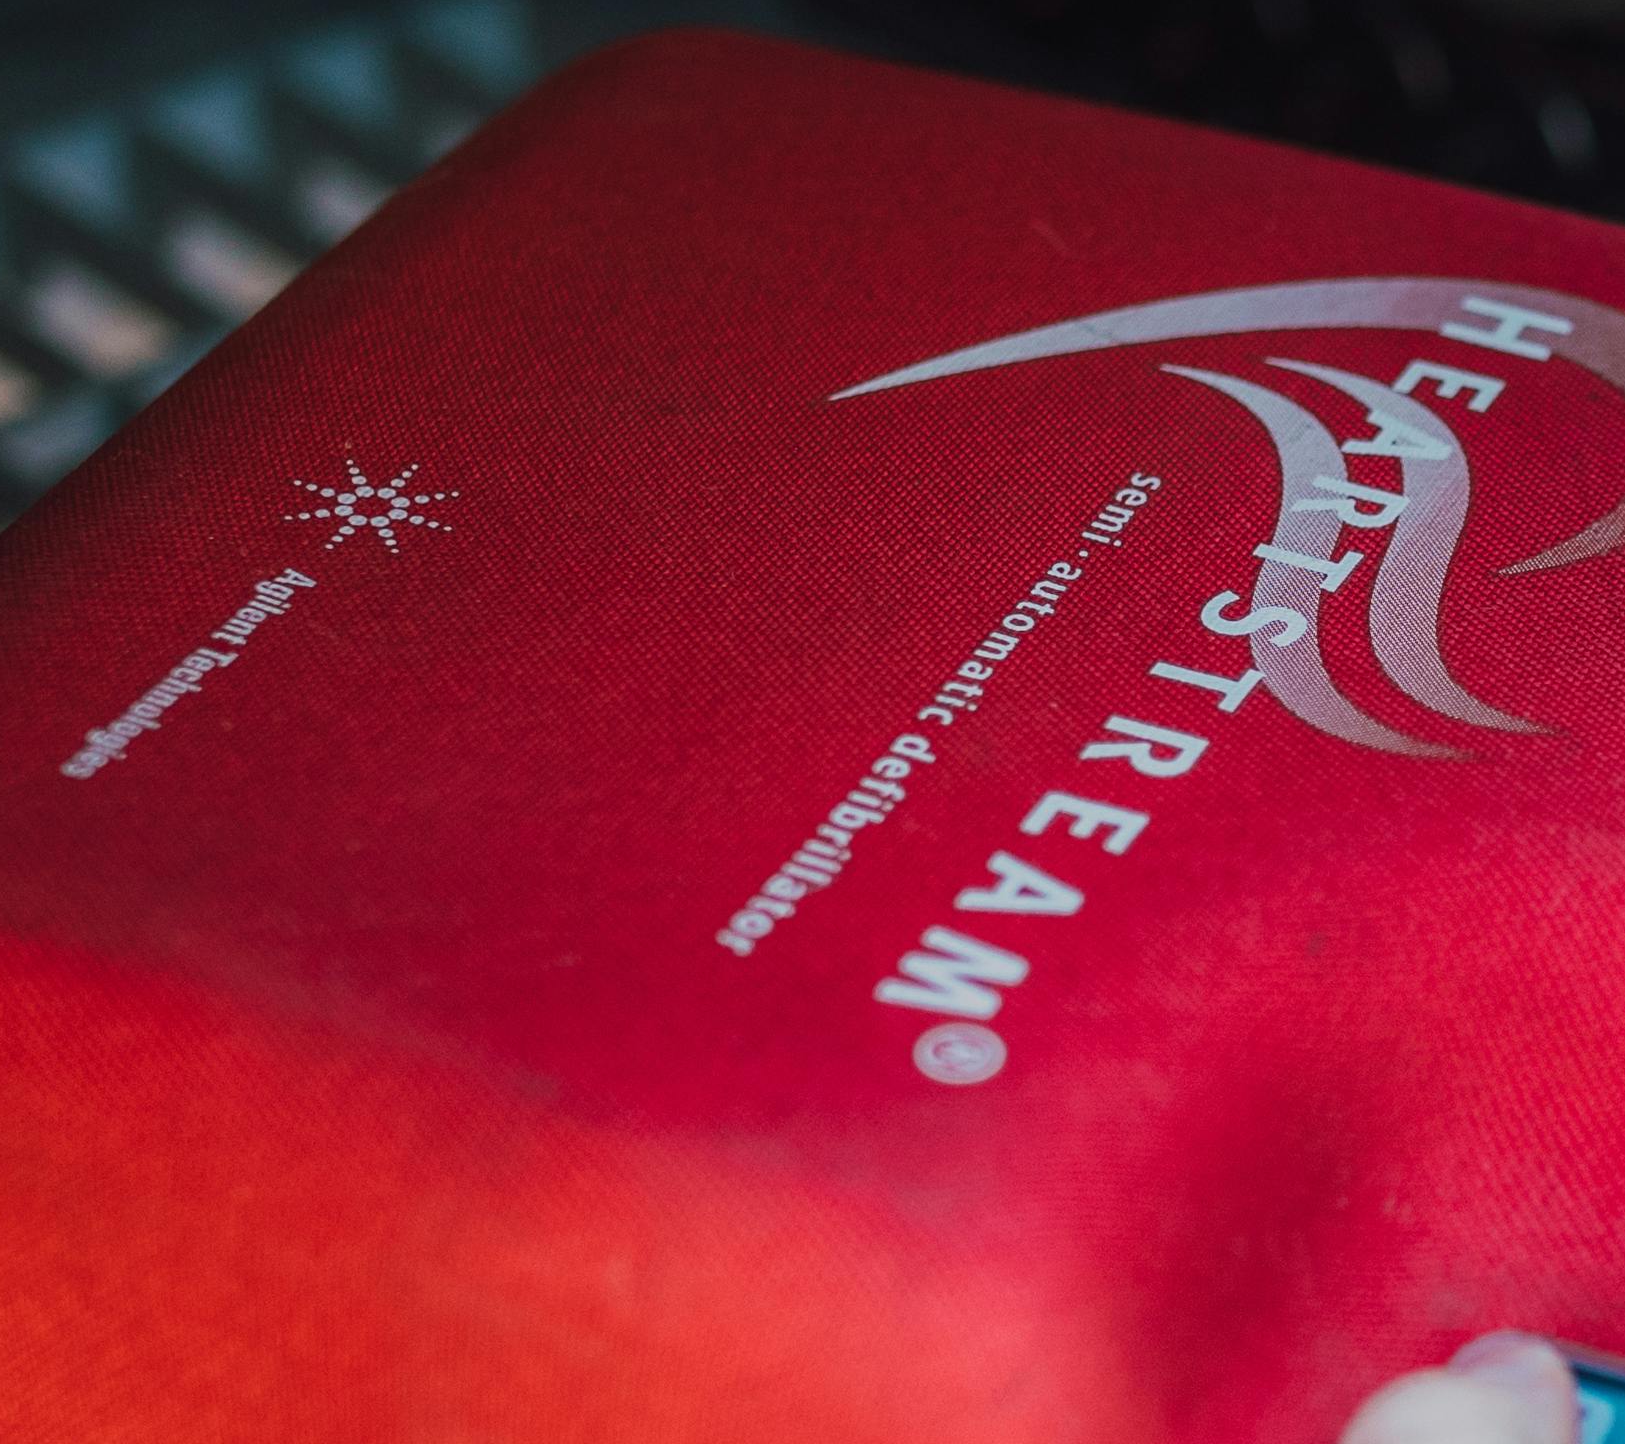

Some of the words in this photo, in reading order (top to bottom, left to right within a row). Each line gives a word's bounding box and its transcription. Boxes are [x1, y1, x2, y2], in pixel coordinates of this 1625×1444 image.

[211, 567, 318, 646] Agilent
[60, 646, 240, 780] Technologies
[715, 732, 937, 957] defibrillator
